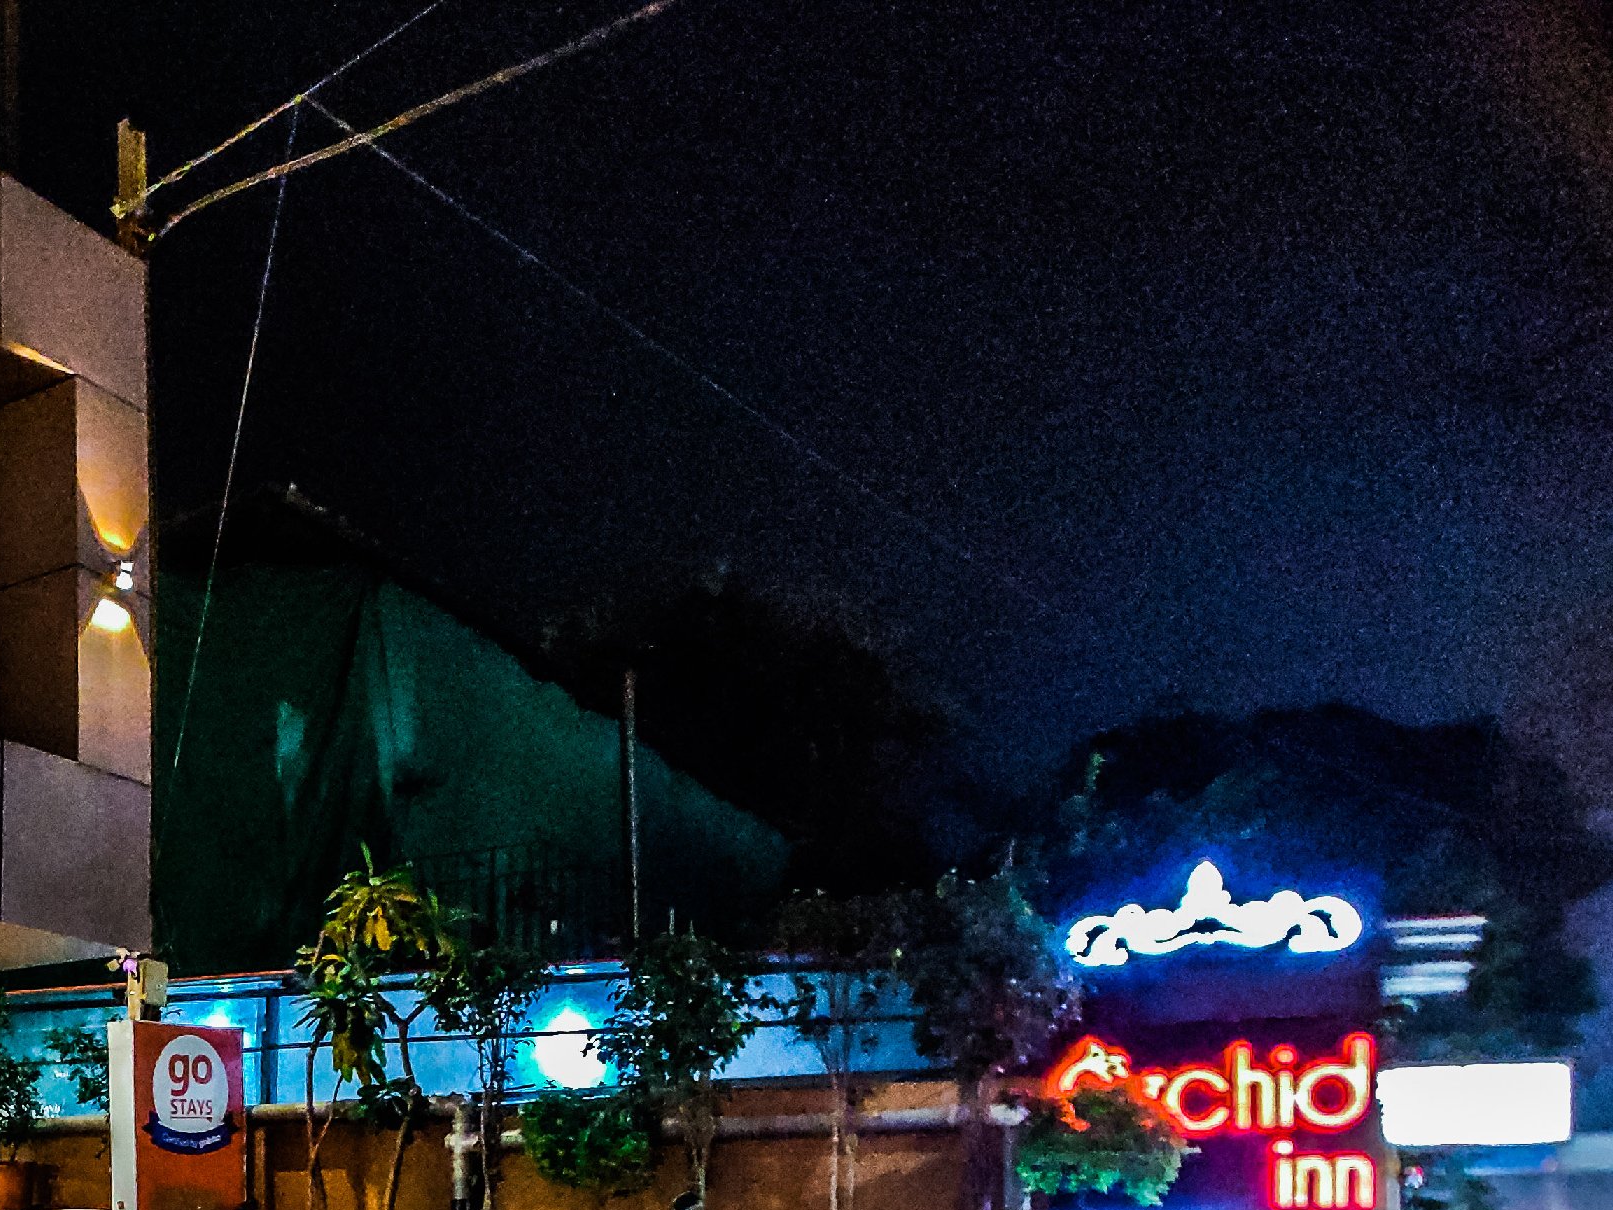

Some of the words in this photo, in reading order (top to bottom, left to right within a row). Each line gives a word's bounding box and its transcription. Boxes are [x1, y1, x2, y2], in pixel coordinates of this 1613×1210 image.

[168, 1053, 213, 1097] go
[170, 1098, 213, 1116] STAYS
[1272, 1139, 1375, 1210] inn
